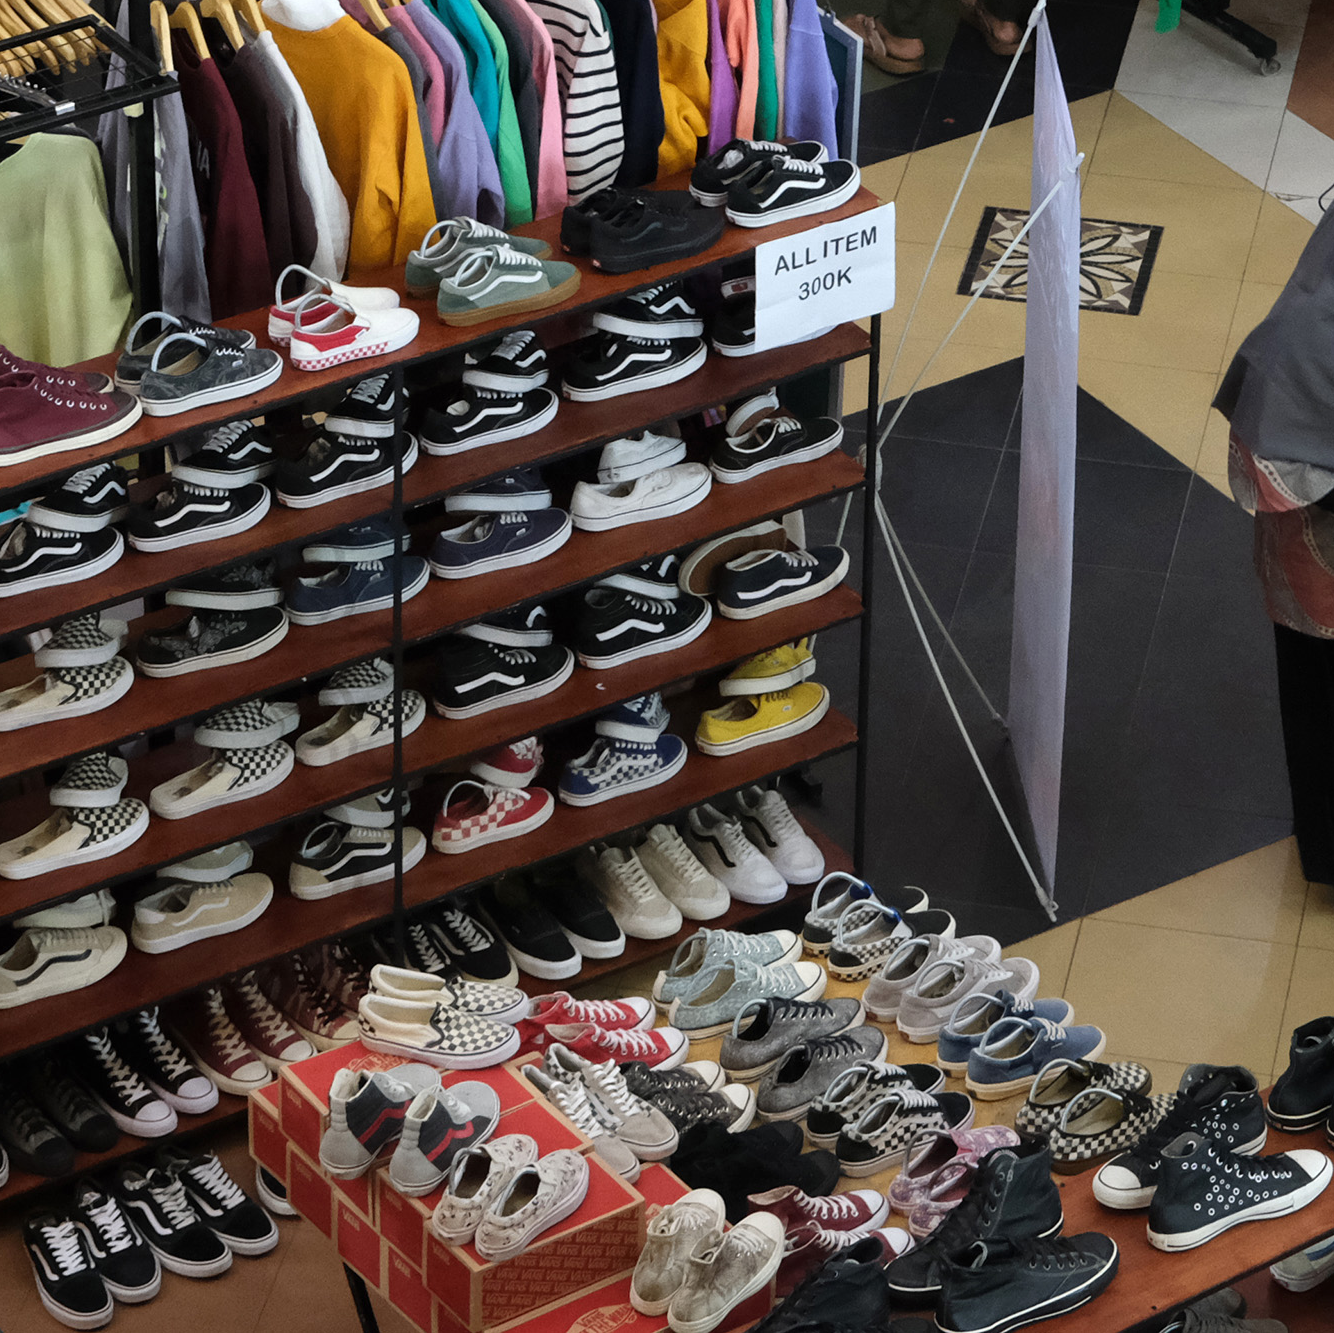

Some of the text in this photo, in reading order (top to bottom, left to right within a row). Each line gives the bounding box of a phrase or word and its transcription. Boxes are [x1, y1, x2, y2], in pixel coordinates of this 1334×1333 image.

[774, 226, 877, 276] ALL ITEM
[798, 266, 852, 301] 300K
